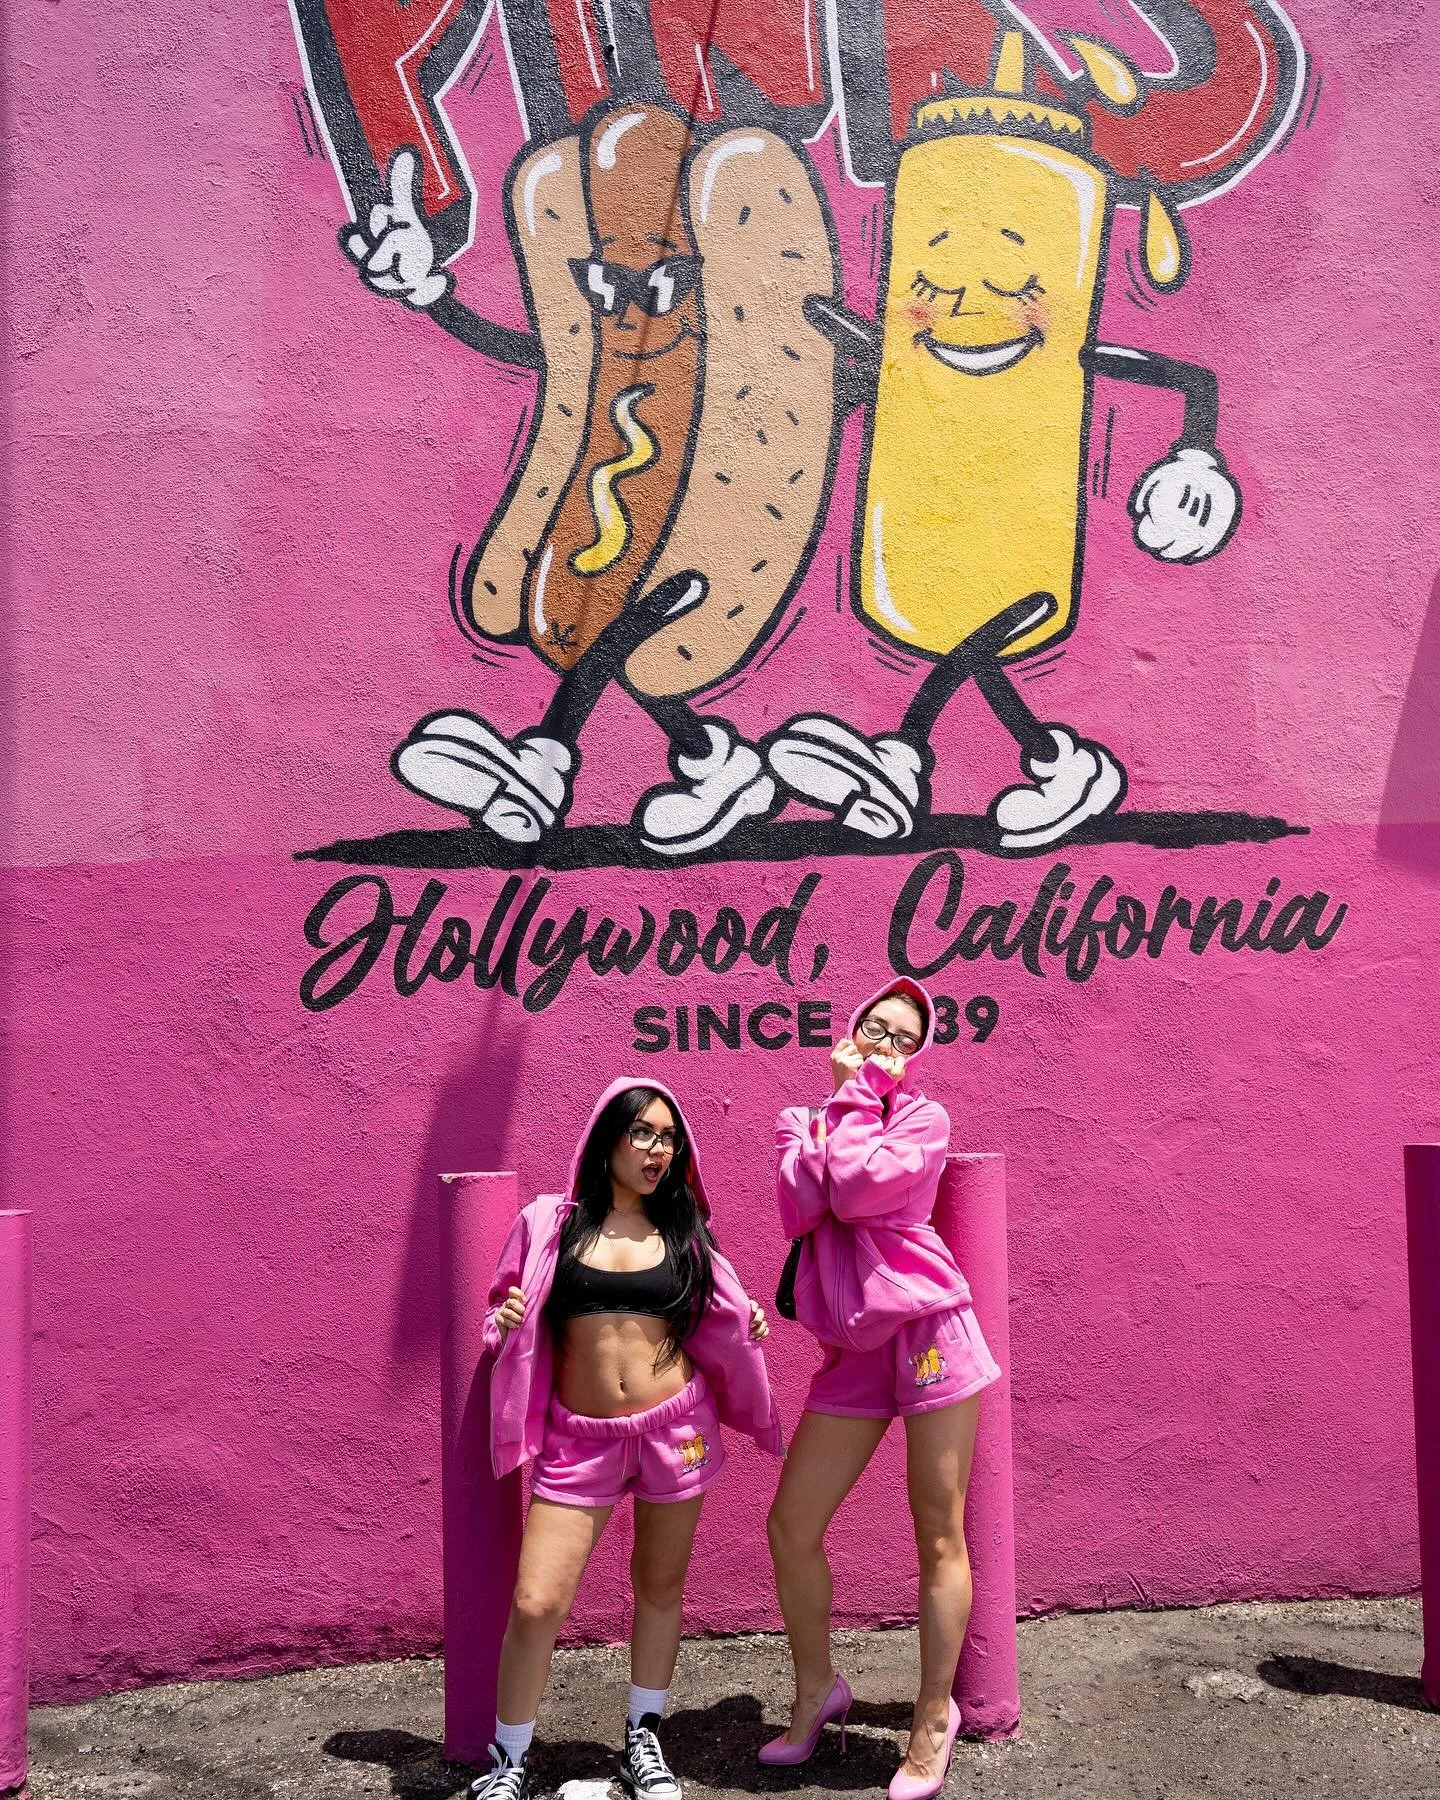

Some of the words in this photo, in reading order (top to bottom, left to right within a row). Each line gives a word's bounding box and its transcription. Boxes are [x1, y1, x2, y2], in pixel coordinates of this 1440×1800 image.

[299, 872, 832, 1014] Hollywood,
[886, 850, 1349, 986] California
[631, 1000, 834, 1053] SINCE
[931, 995, 1000, 1045] 39
